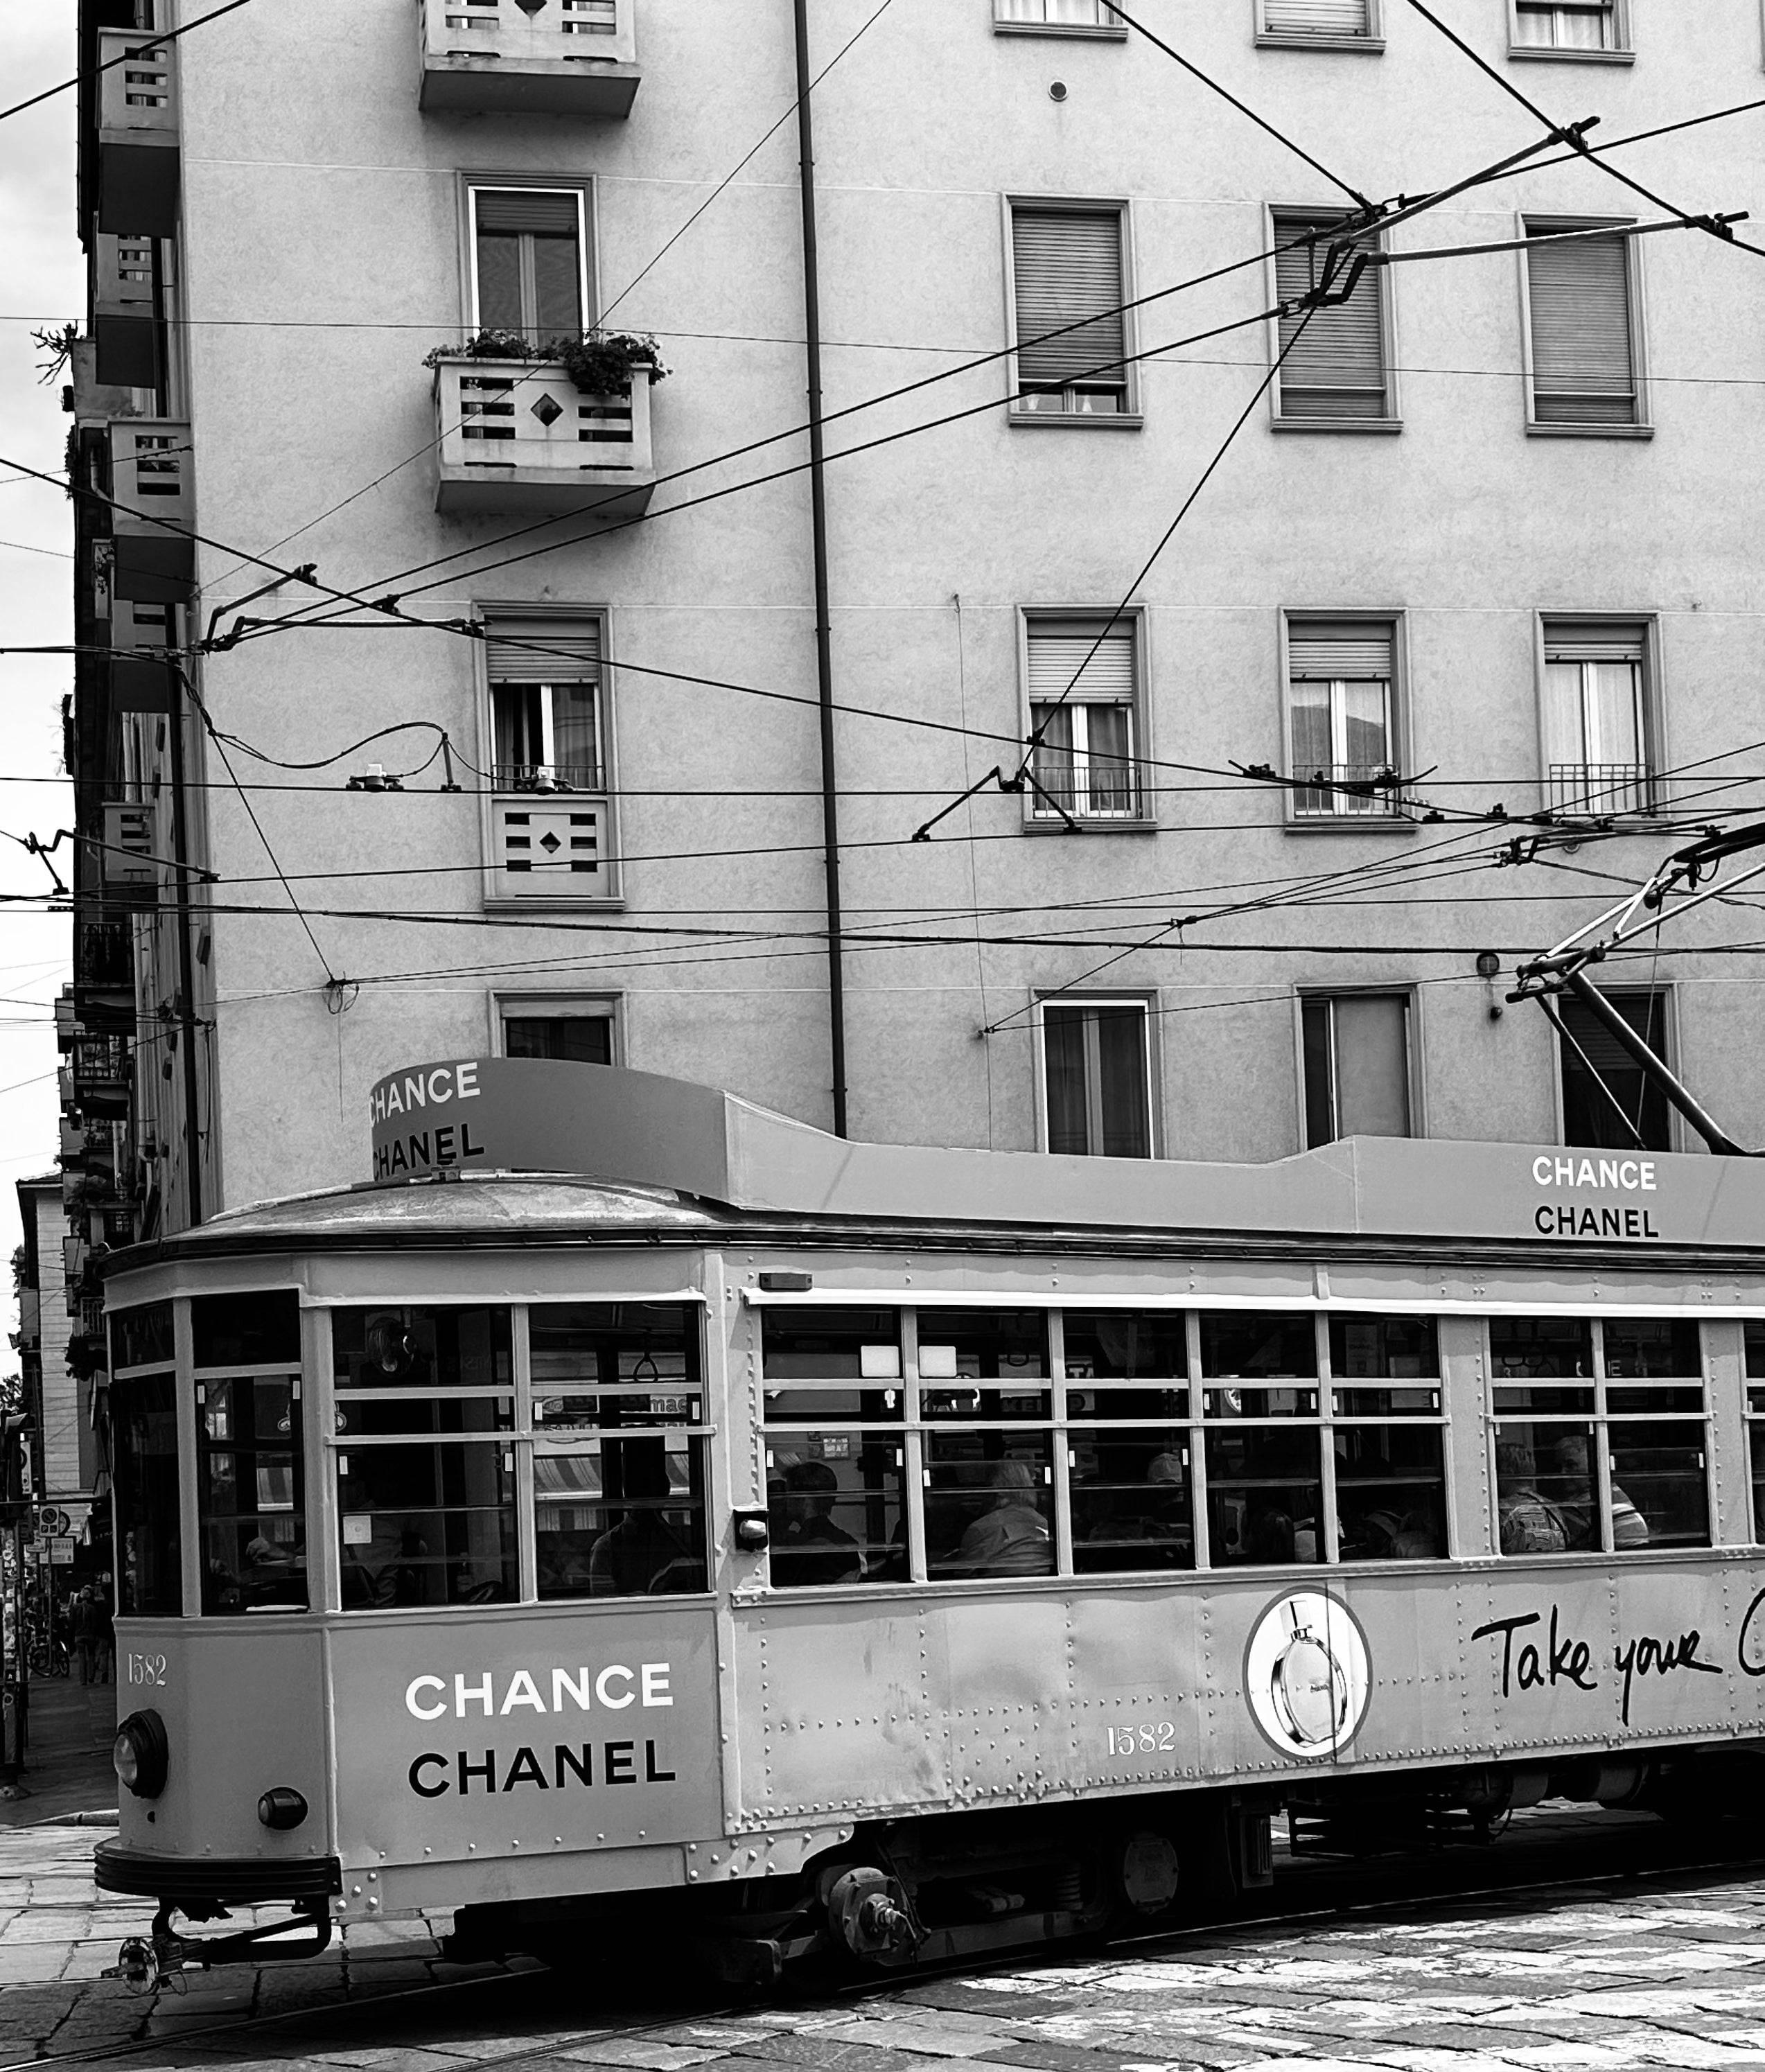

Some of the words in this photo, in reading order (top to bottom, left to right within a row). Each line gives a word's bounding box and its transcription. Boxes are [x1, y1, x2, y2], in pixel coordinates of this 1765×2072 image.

[369, 1062, 480, 1128] CHANCE
[1531, 1155, 1657, 1191] CHANCE
[1534, 1205, 1659, 1238] CHANEL
[128, 1653, 166, 1686] 1582
[1471, 1604, 1598, 1698] Take
[405, 1662, 674, 1721] CHANCE
[1107, 1721, 1175, 1755] 1582
[408, 1739, 676, 1798] CHANEL
